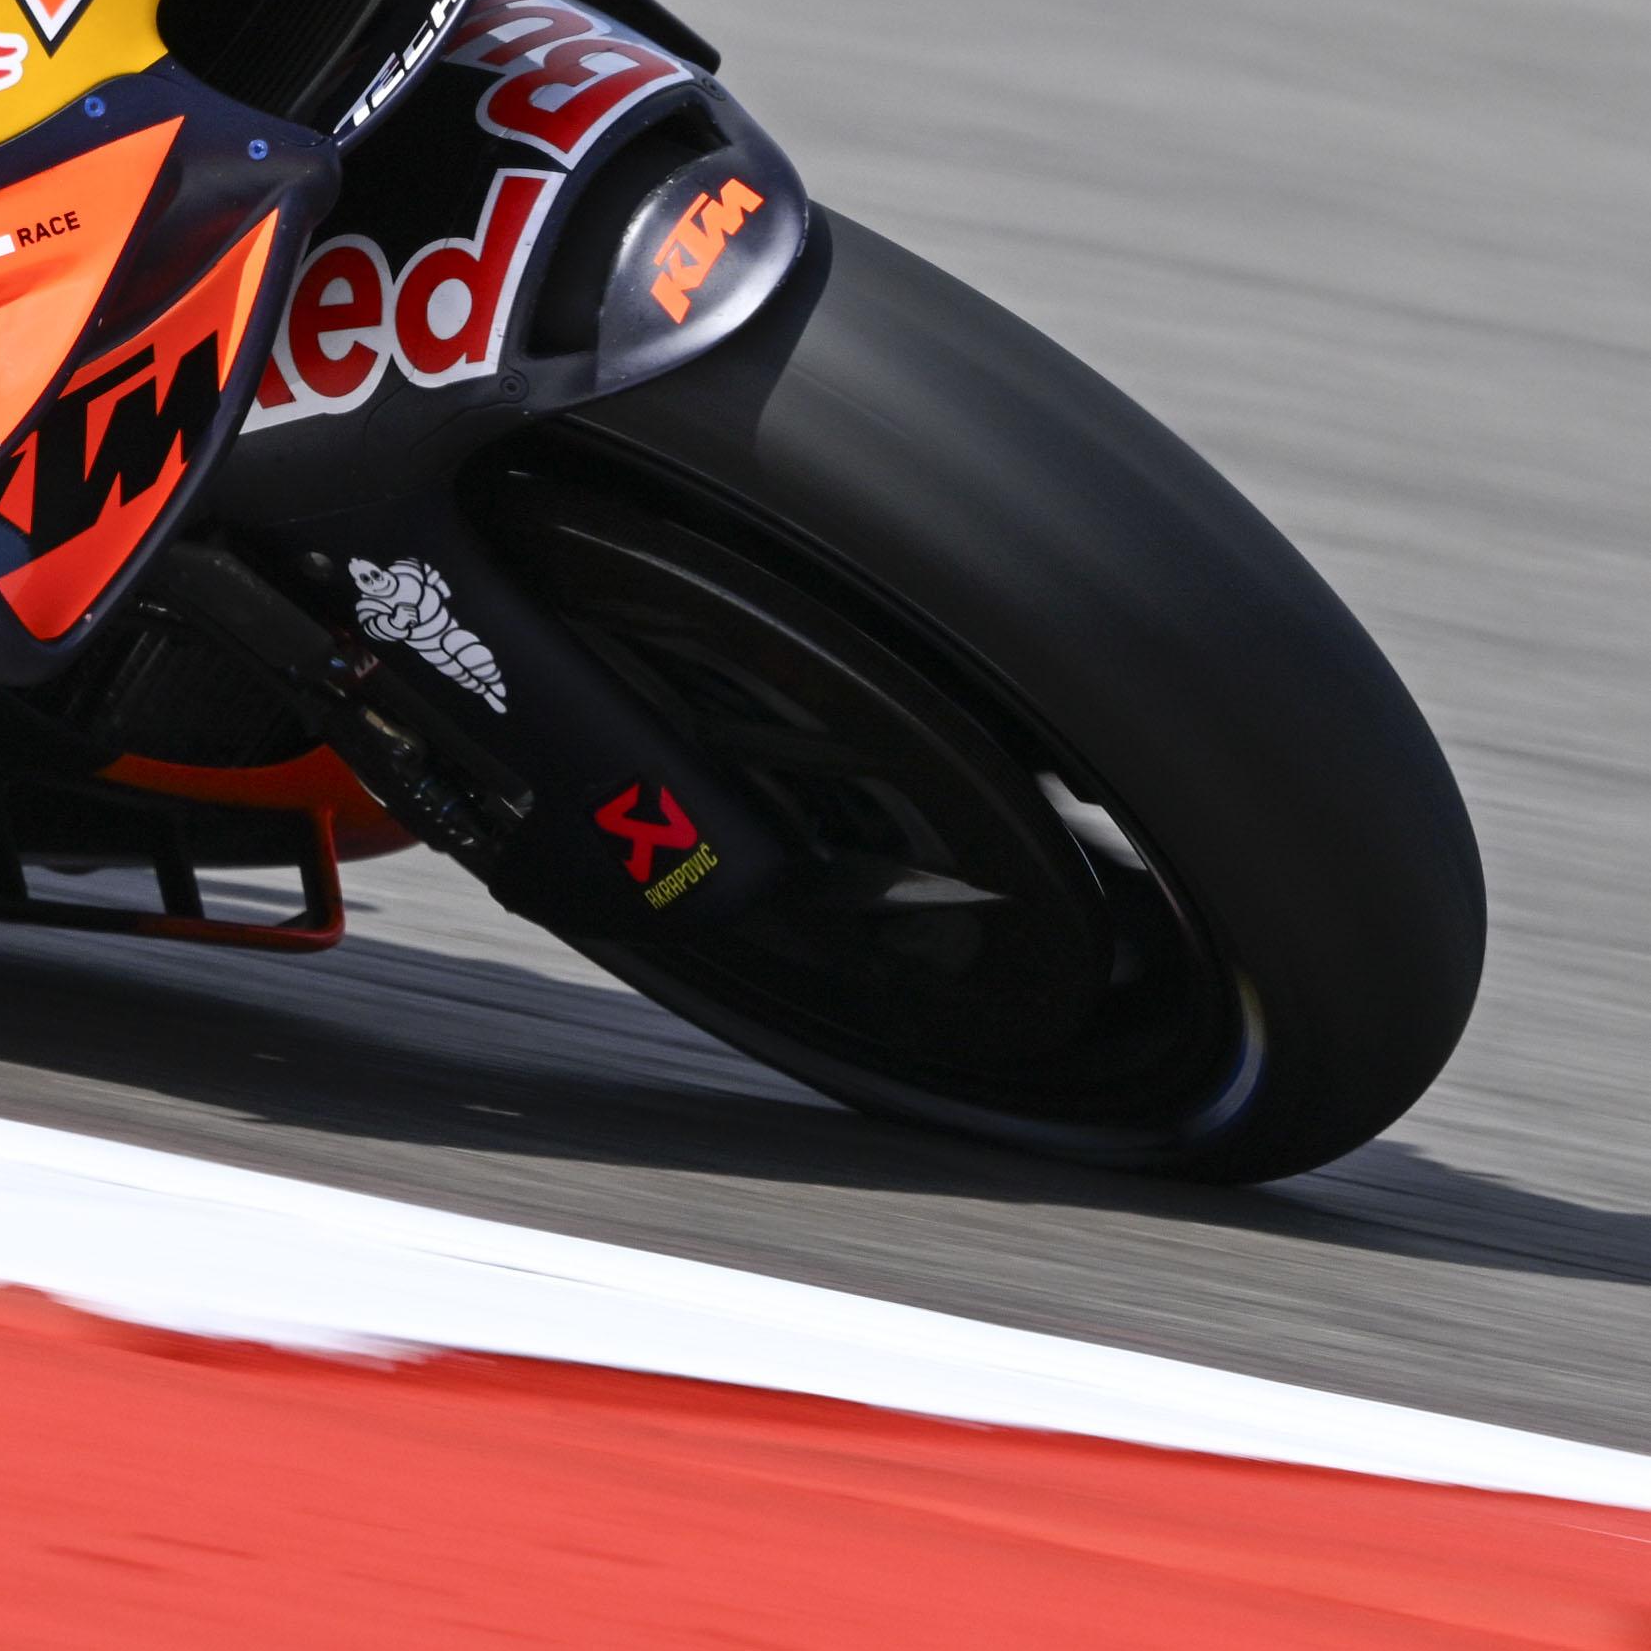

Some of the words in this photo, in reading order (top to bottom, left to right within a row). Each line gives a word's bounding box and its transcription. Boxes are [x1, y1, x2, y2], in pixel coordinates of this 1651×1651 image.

[16, 211, 81, 248] RACE
[240, 169, 565, 434] ed
[652, 177, 764, 325] KTM
